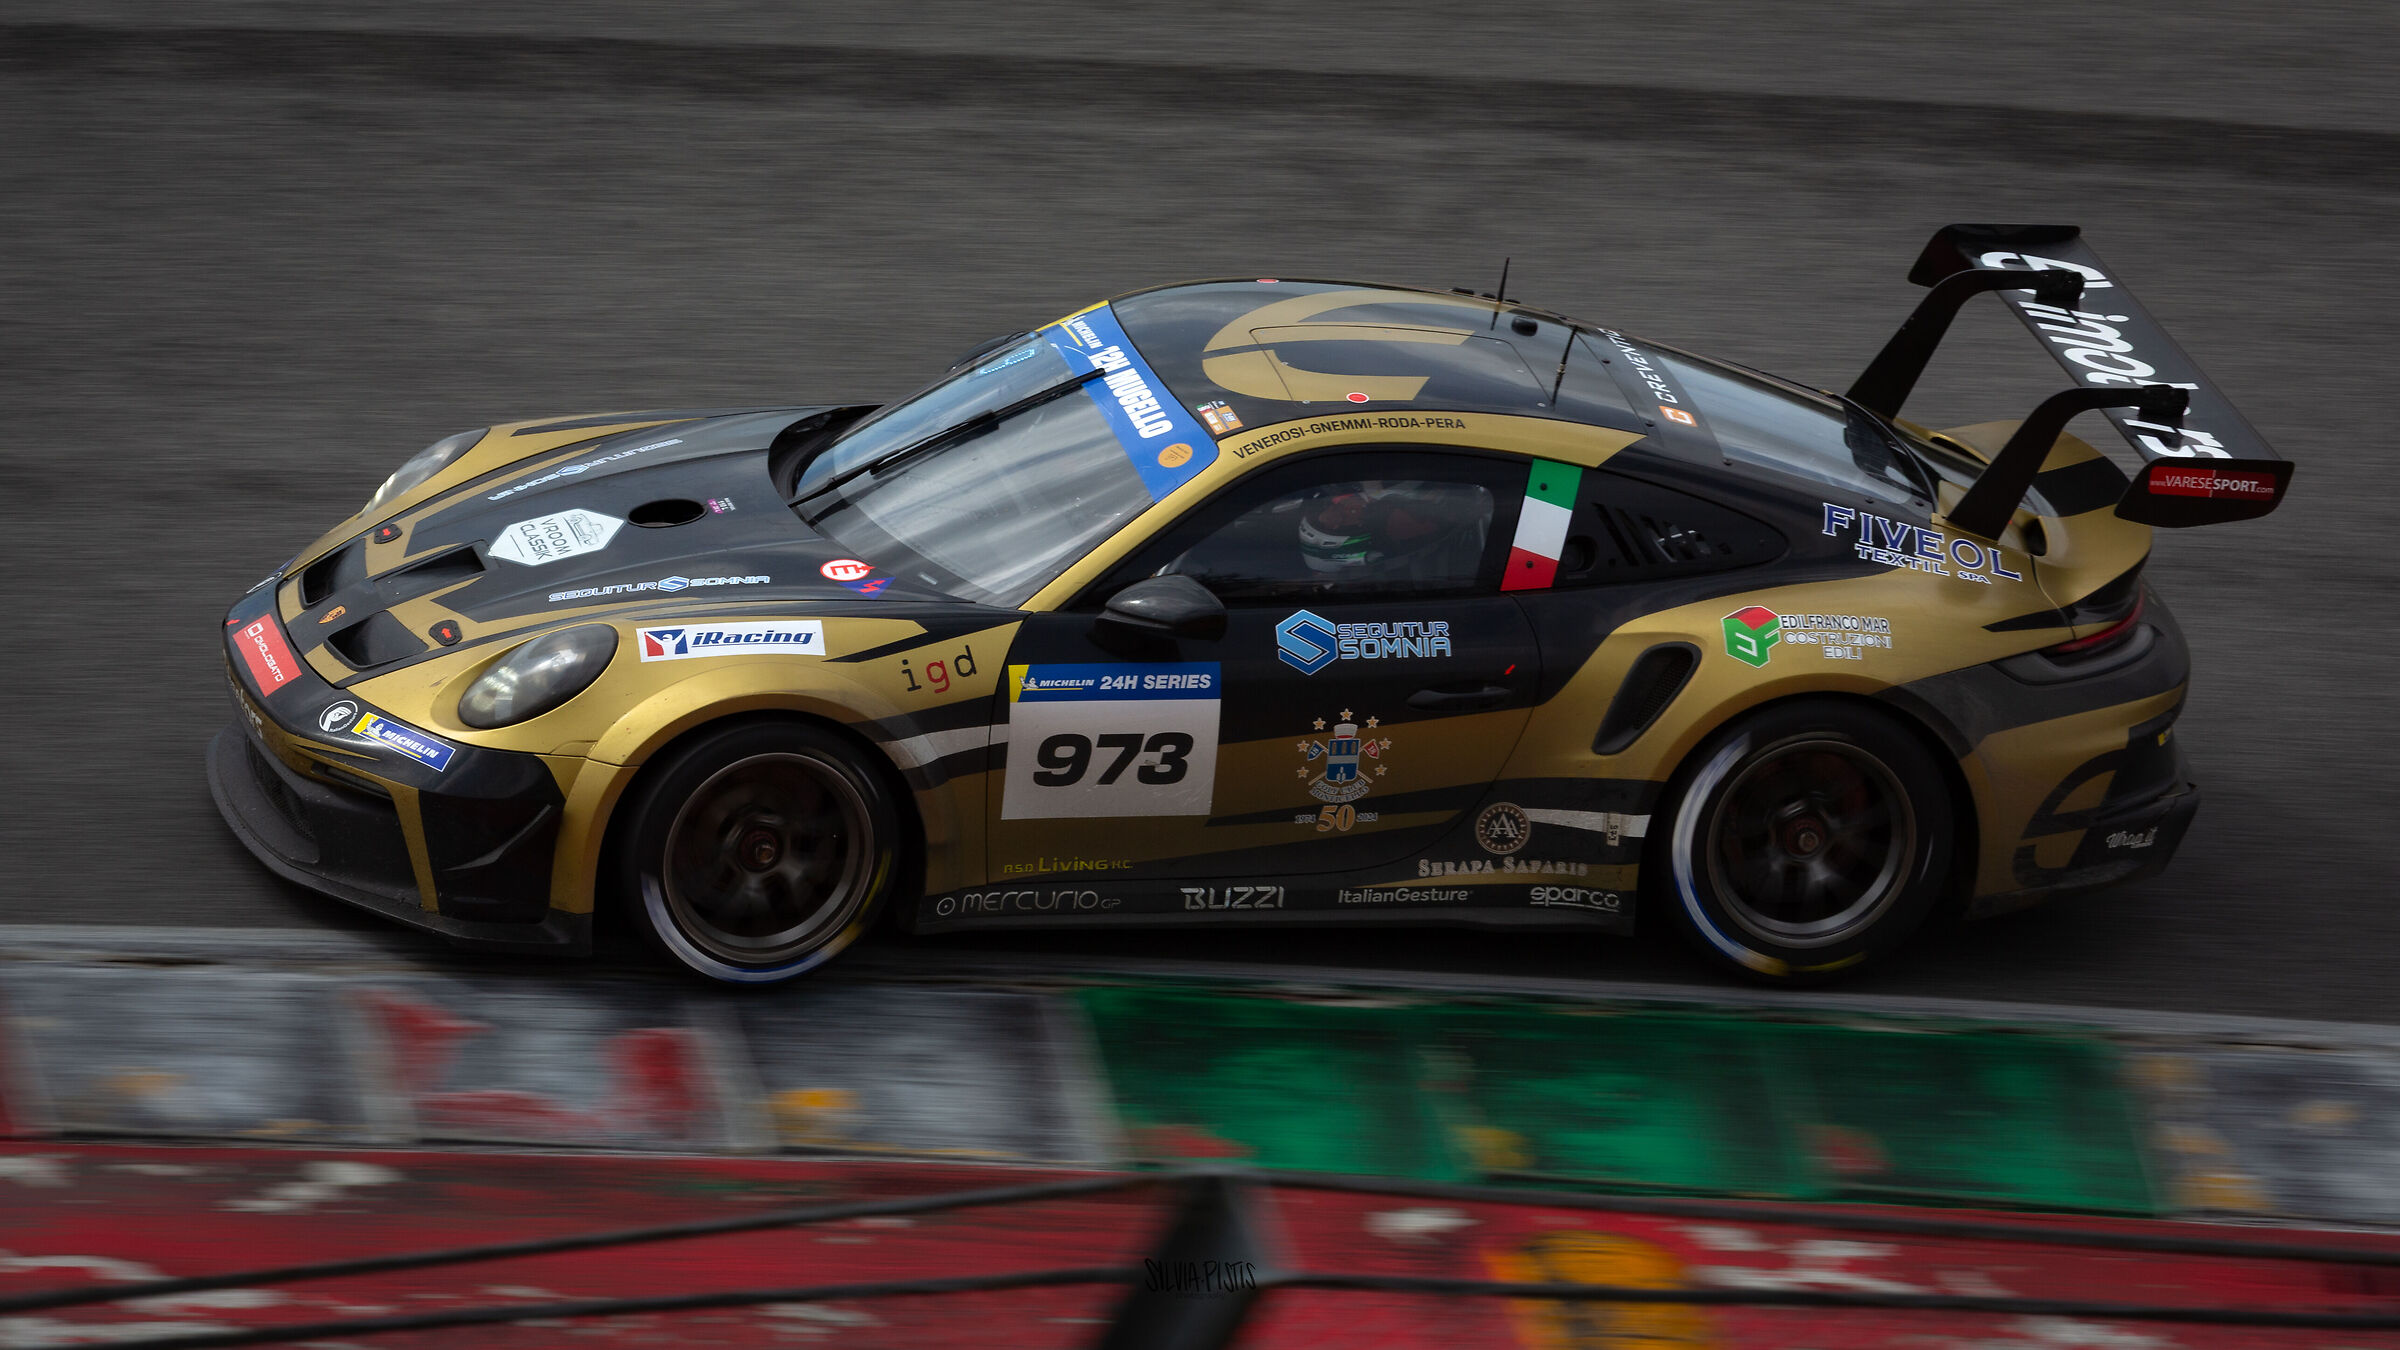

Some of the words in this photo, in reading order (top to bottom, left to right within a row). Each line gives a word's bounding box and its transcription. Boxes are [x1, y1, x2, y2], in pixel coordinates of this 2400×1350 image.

[1072, 319, 1103, 349] MICHELIN
[1088, 345, 1131, 373] 12H
[1103, 367, 1173, 439] MUGELLO
[1233, 417, 1465, 459] VENEROSI-GNEMMI-RODA-PERA
[540, 518, 572, 556] VROOM
[1822, 502, 2022, 581] FIVEOL
[1854, 543, 1950, 576] TEXTIL
[1957, 570, 1992, 584] SPA
[549, 581, 657, 601] SEQUITUR
[688, 575, 770, 589] SOMNIA
[692, 629, 815, 646] iRacing
[1337, 621, 1450, 639] SEQUITUR
[1780, 615, 1860, 631] EDILFRANCO
[1862, 617, 1890, 634] MAR
[1338, 637, 1451, 659] SOMNIA
[1784, 632, 1892, 649] COSTRUZIONI
[1823, 646, 1862, 660] EDILI
[254, 635, 285, 683] OMOLOGATO
[1039, 679, 1095, 687] MICHELIN
[1100, 675, 1138, 690] 24H
[1143, 674, 1211, 690] SERIES
[381, 728, 439, 760] MICHELIN
[1033, 731, 1194, 787] 973
[1316, 804, 1356, 832] 50
[1418, 858, 1496, 877] SERAPA
[1503, 857, 1588, 876] SAFARIS
[1180, 886, 1284, 910] BUZZI
[1338, 888, 1468, 903] ItalianGesture
[1530, 886, 1620, 909] sparco
